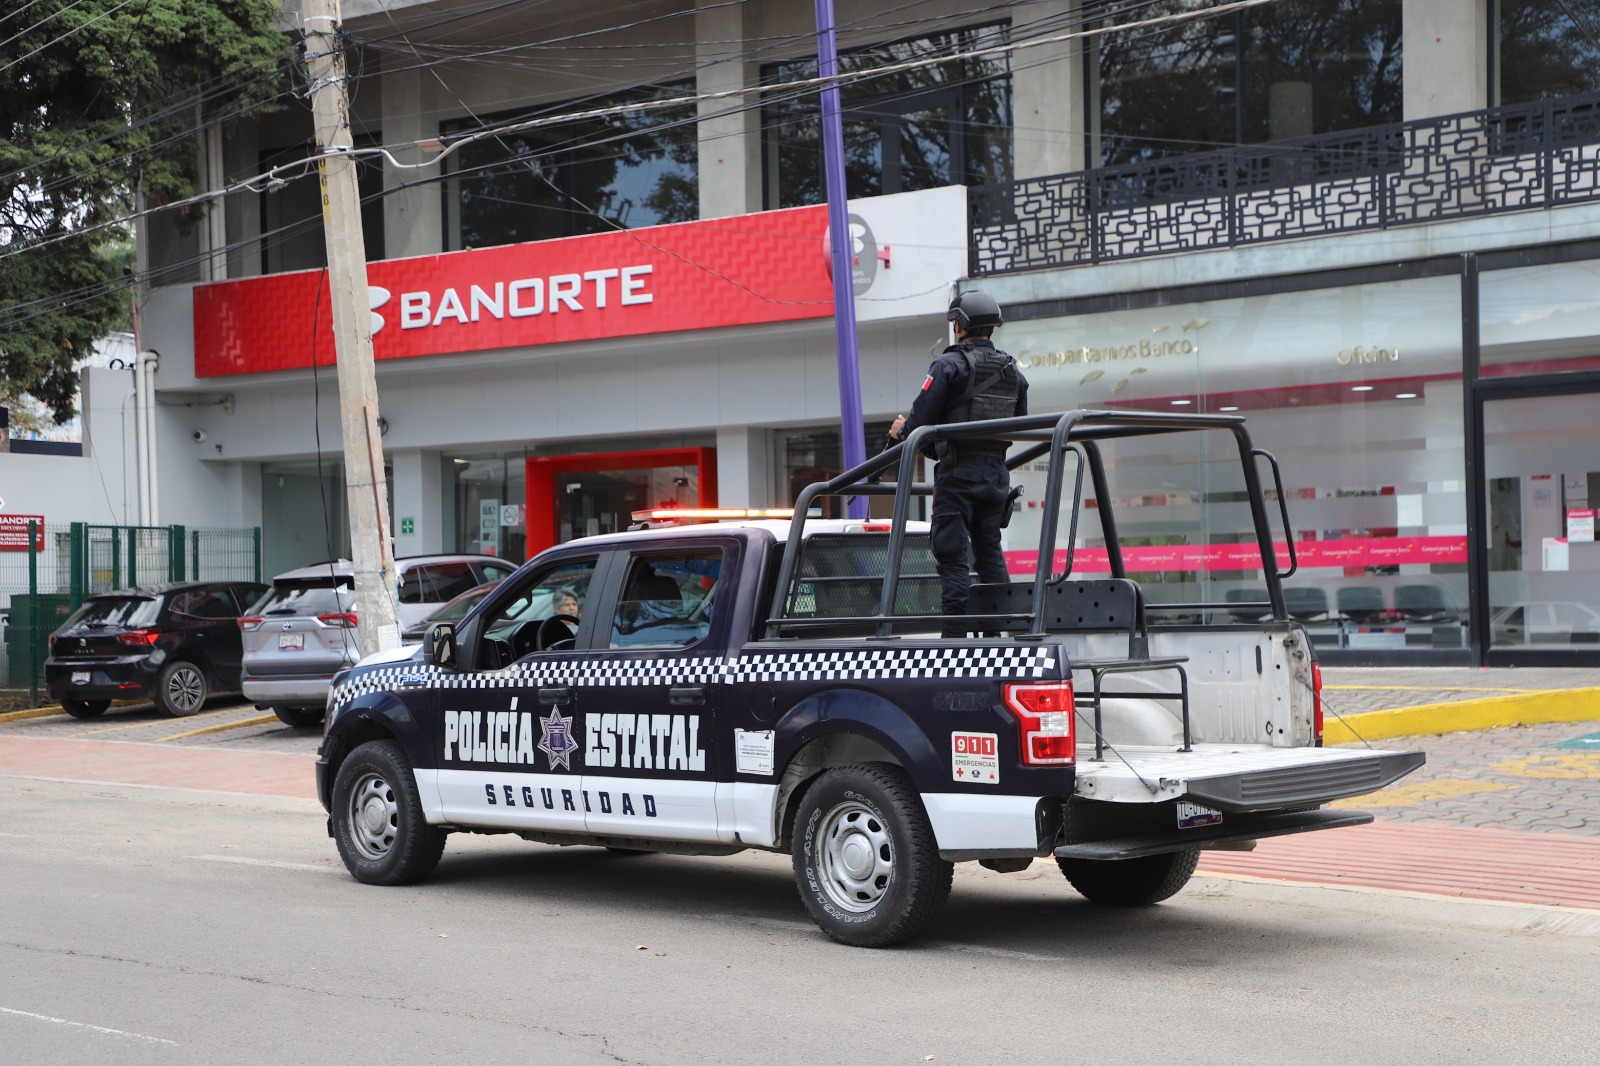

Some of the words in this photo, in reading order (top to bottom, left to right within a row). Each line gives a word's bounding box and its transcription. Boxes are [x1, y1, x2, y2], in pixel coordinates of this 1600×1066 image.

[401, 264, 653, 329] BANORTE
[1017, 344, 1137, 370] Compartamos
[444, 697, 534, 765] POLICÍA
[585, 712, 706, 772] ESTATAL
[957, 738, 992, 753] 911
[955, 760, 996, 768] EMERGENCIAS
[485, 783, 657, 818] SEGURIDAD
